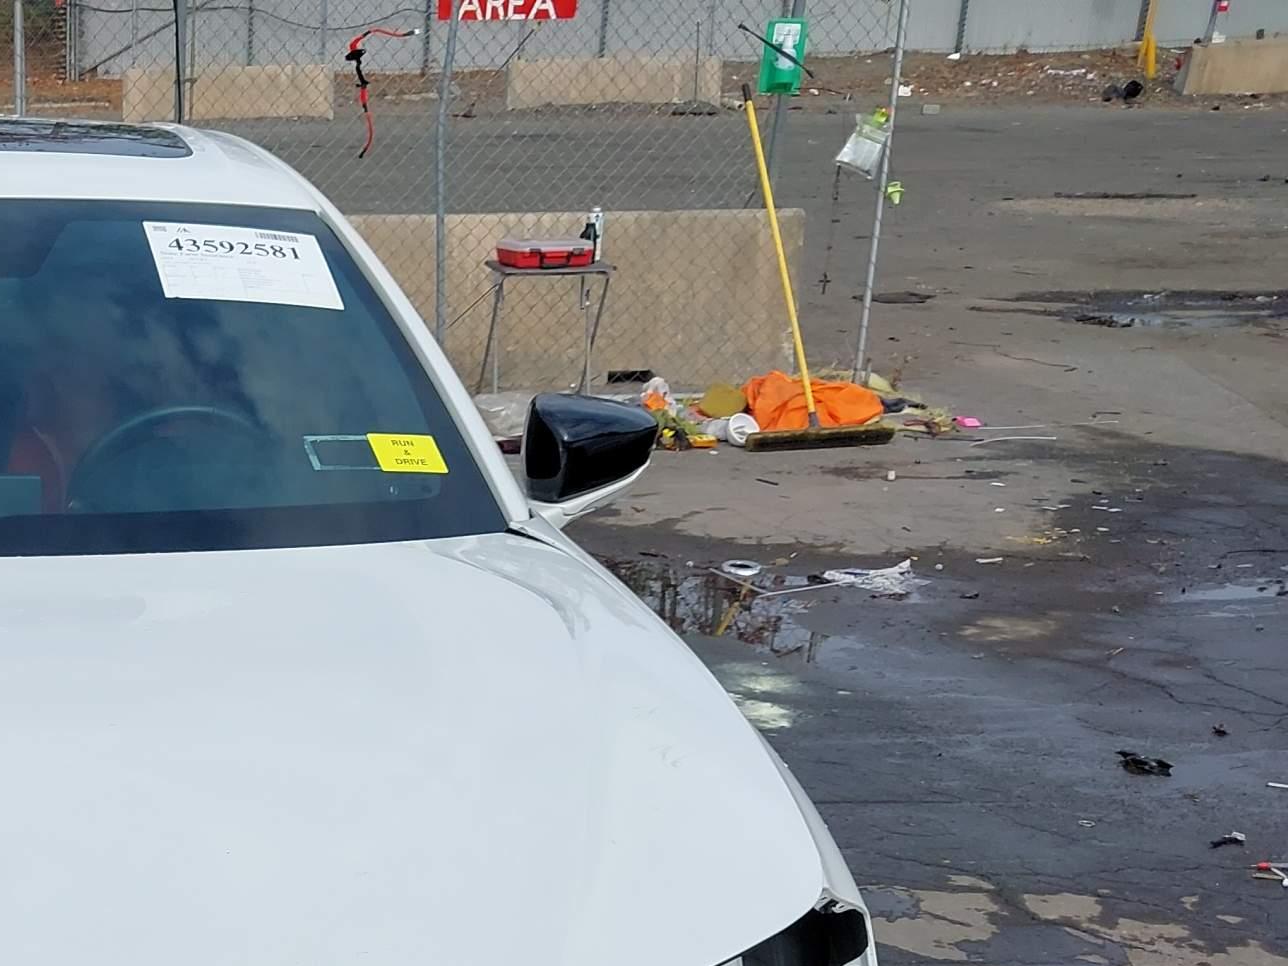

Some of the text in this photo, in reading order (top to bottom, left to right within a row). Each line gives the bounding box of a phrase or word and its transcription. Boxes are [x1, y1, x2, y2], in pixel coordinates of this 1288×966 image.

[457, 0, 558, 20] AREA
[168, 238, 301, 260] 43592581
[391, 439, 414, 447] RUN
[395, 458, 428, 466] DRIVE
